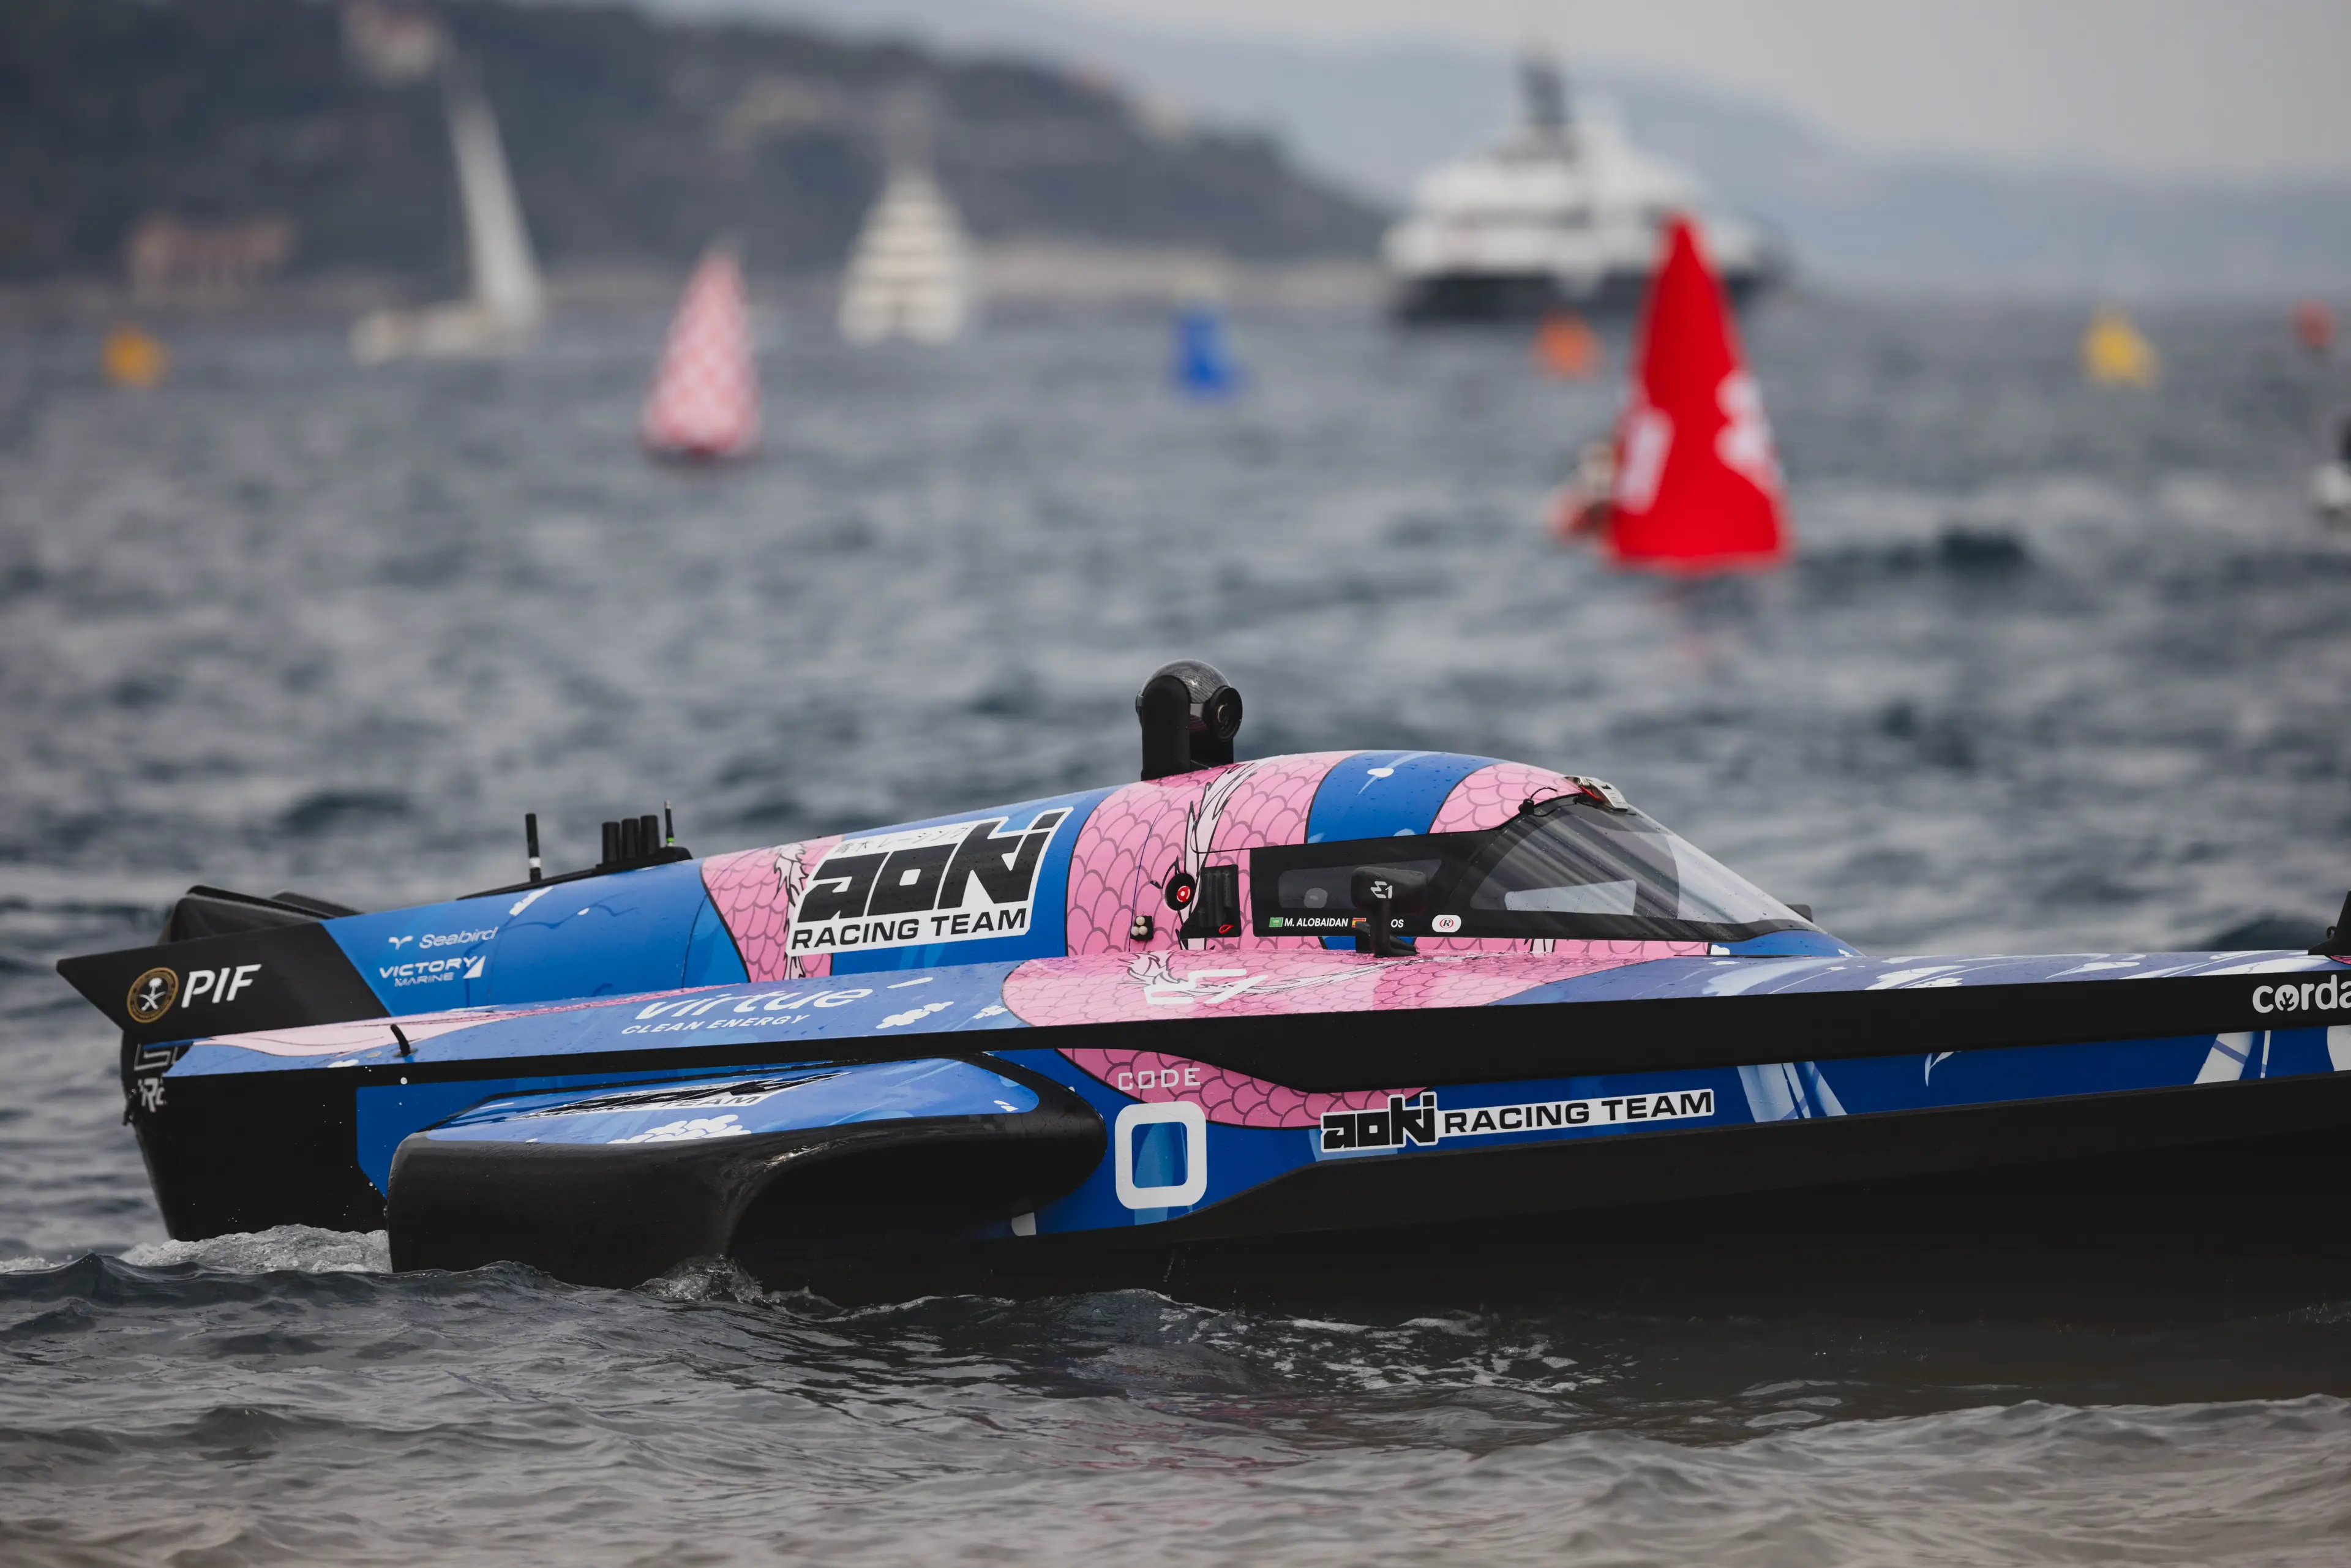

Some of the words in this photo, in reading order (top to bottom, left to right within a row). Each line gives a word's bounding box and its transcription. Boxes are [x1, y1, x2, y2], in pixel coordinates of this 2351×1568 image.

[791, 918, 920, 950] RACING
[930, 908, 1027, 936] TEAM
[1284, 918, 1295, 927] M.
[1296, 917, 1349, 927] ALOBAIDAN
[419, 926, 500, 949] Seabird
[378, 955, 478, 978] VICTORY
[181, 963, 262, 1008] PIF
[394, 972, 455, 988] MARINE
[621, 1020, 706, 1035] CLEAN
[706, 1014, 811, 1029] ENERGY
[1118, 1067, 1201, 1090] CODE
[659, 1095, 761, 1108] TEAM
[1445, 1101, 1590, 1134] RACING
[1601, 1092, 1712, 1121] TEAM
